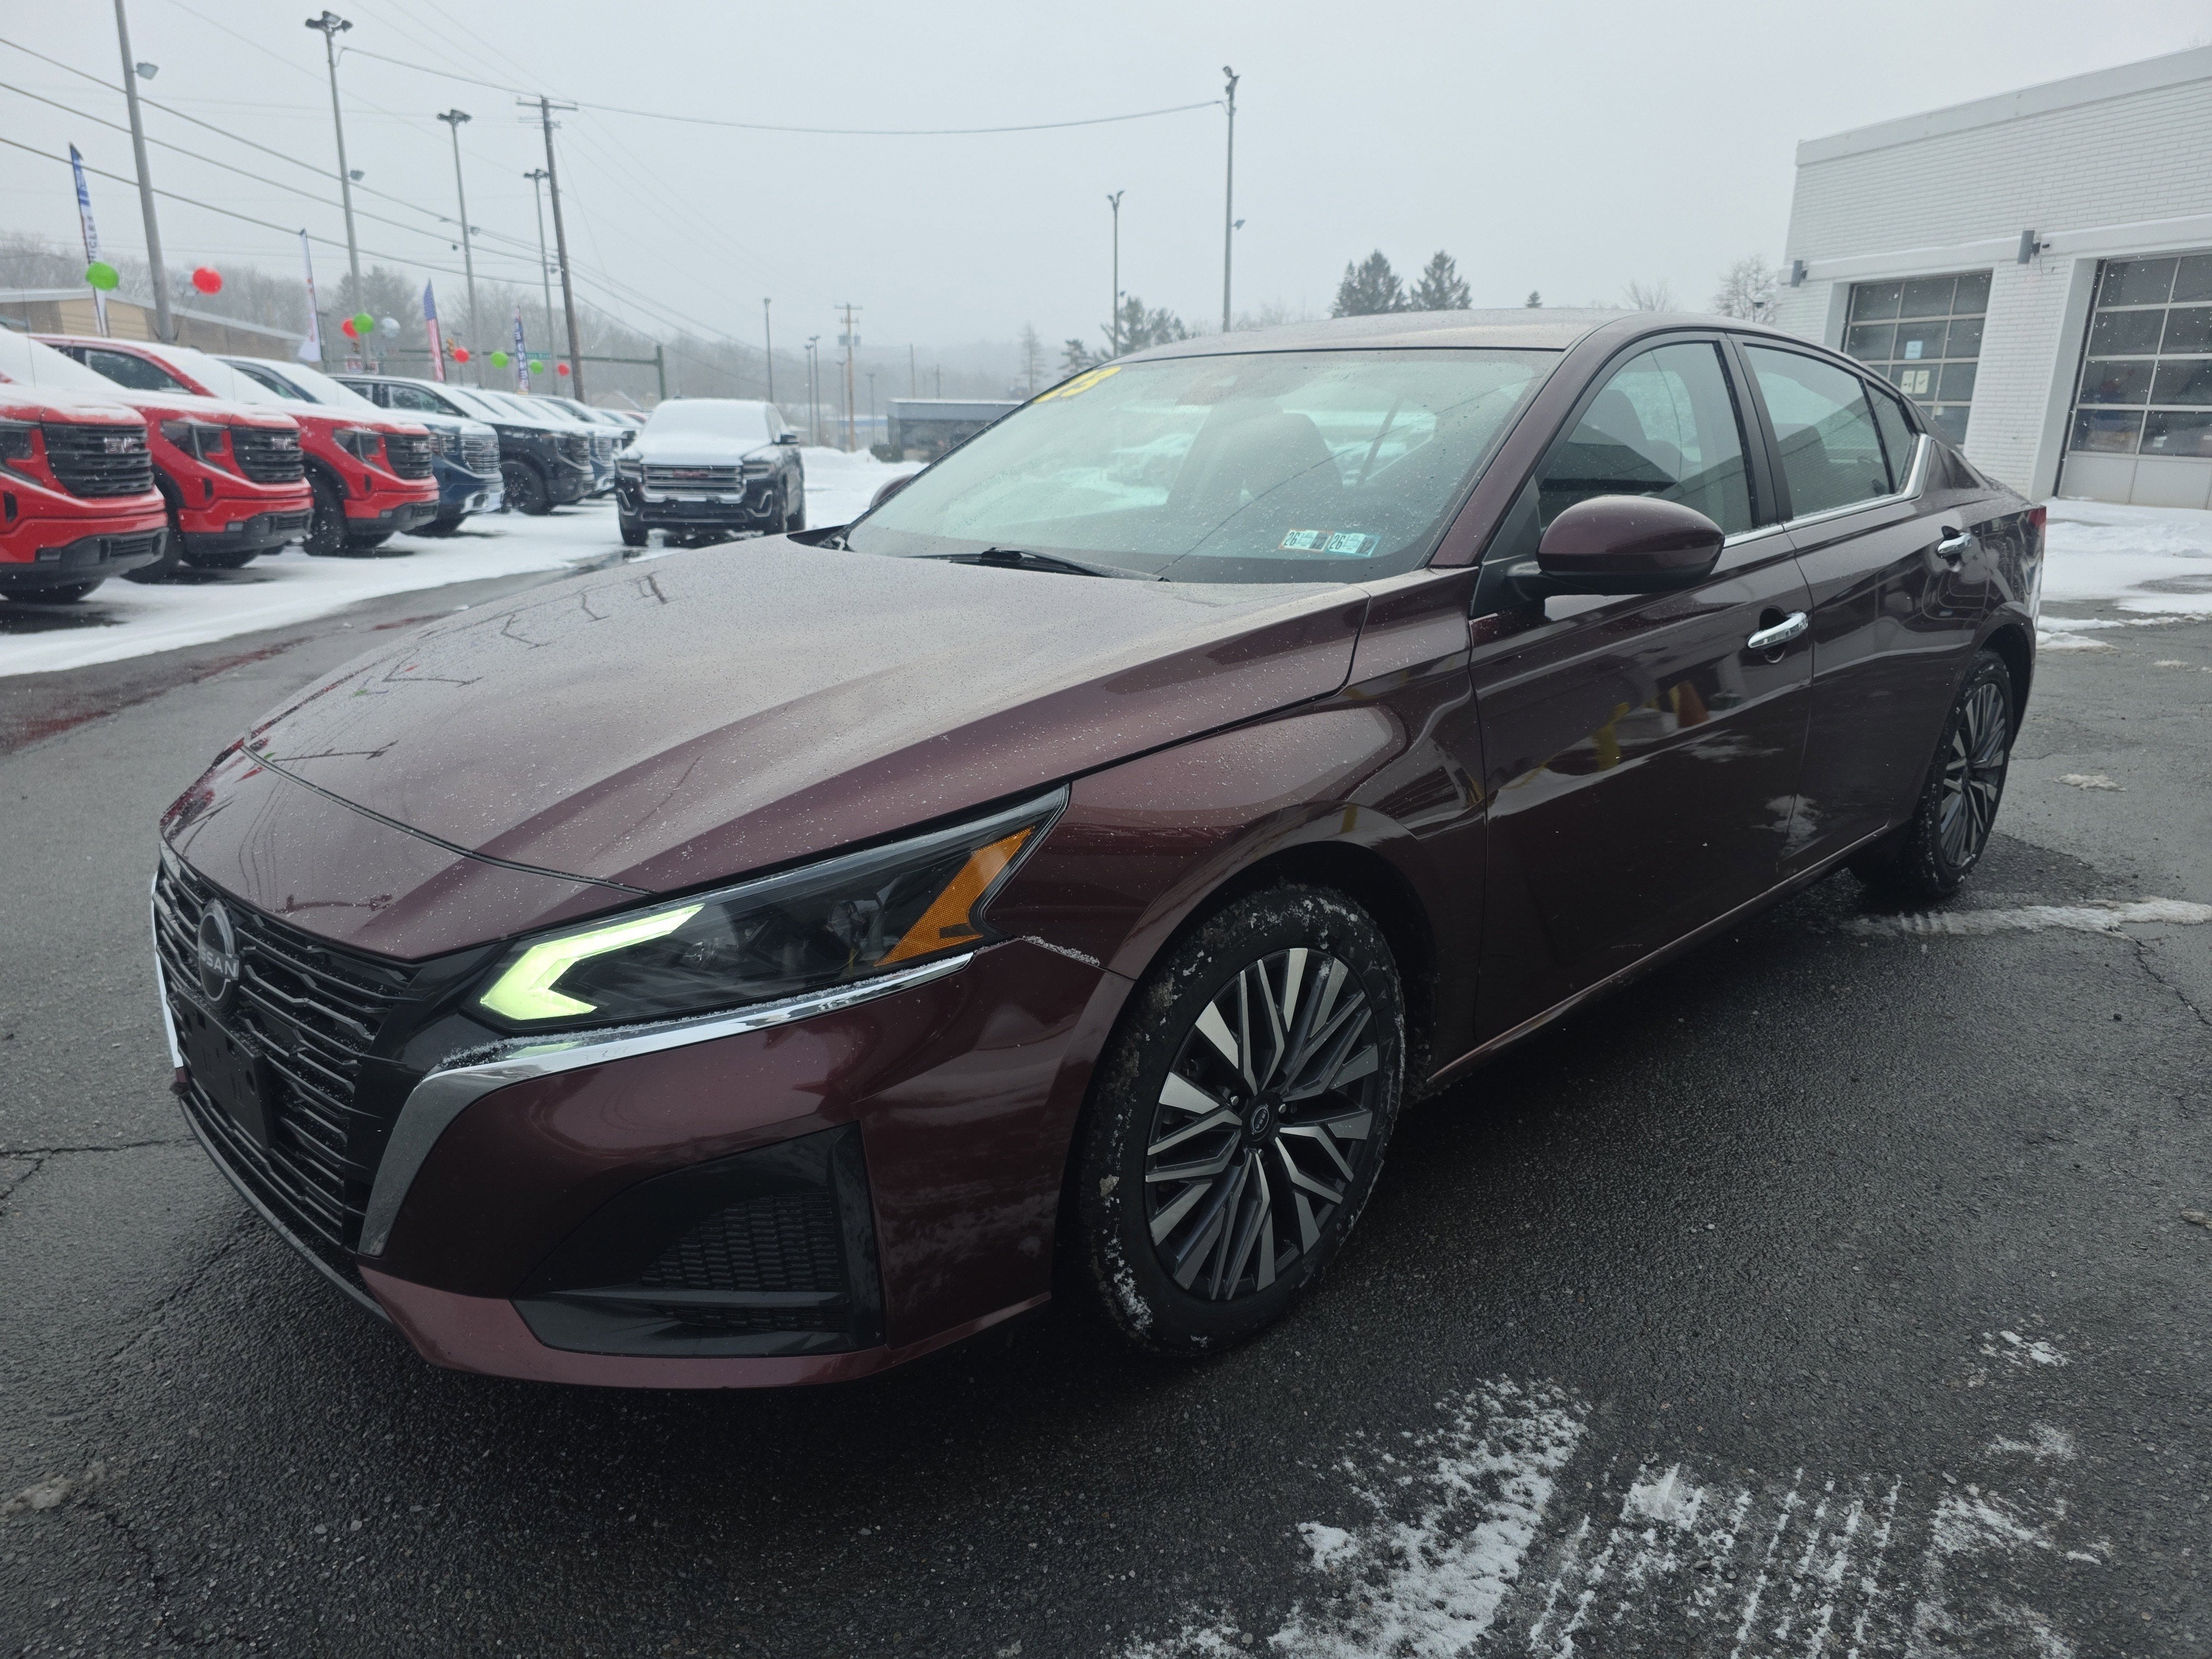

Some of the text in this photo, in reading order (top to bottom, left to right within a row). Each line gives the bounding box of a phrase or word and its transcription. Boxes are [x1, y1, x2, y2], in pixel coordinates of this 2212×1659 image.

[1283, 531, 1301, 546] 26
[1329, 535, 1346, 549] 26
[201, 945, 237, 978] SSAN
